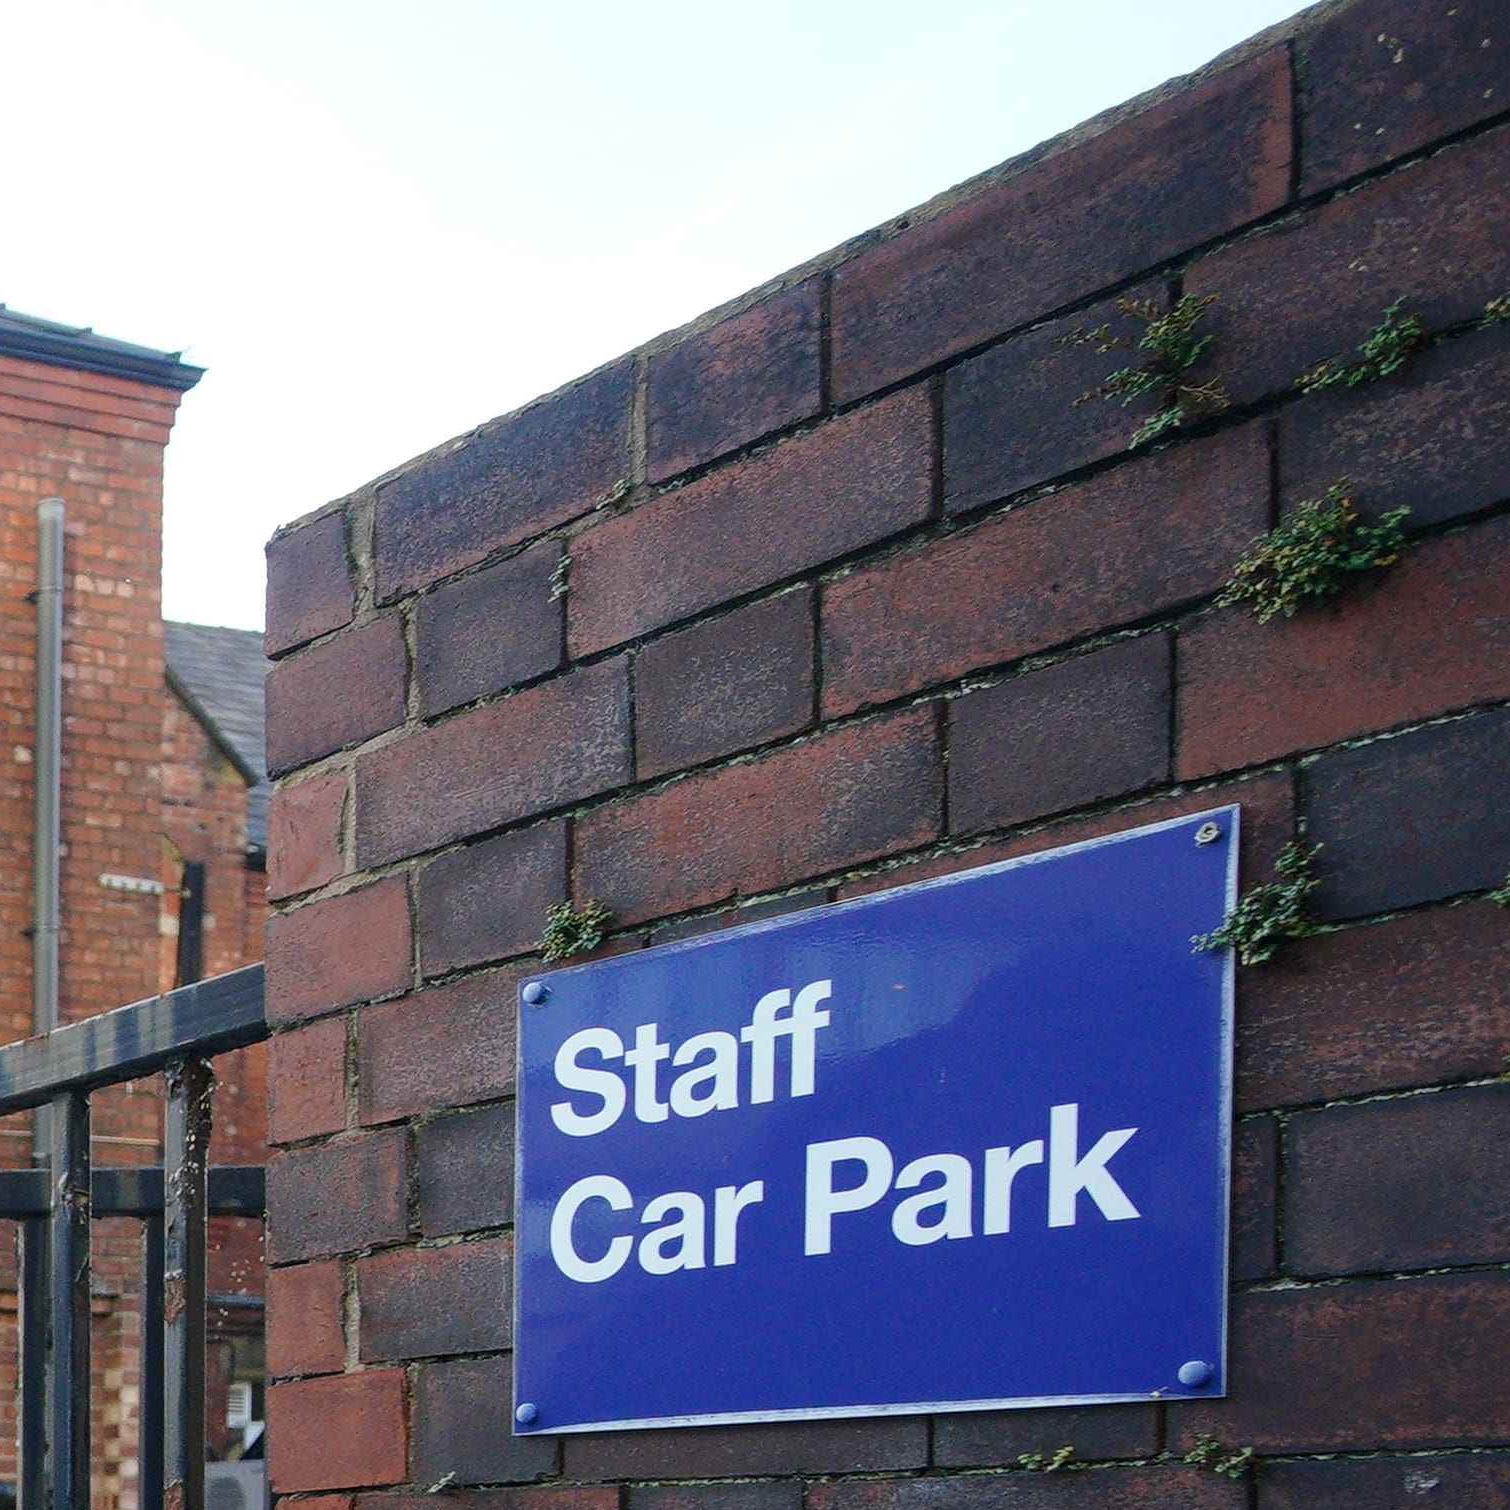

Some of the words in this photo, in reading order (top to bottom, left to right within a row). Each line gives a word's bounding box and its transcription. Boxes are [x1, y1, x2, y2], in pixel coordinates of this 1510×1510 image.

[550, 979, 832, 1137] Staff
[549, 1174, 764, 1283] Car
[804, 1102, 1141, 1256] Park
